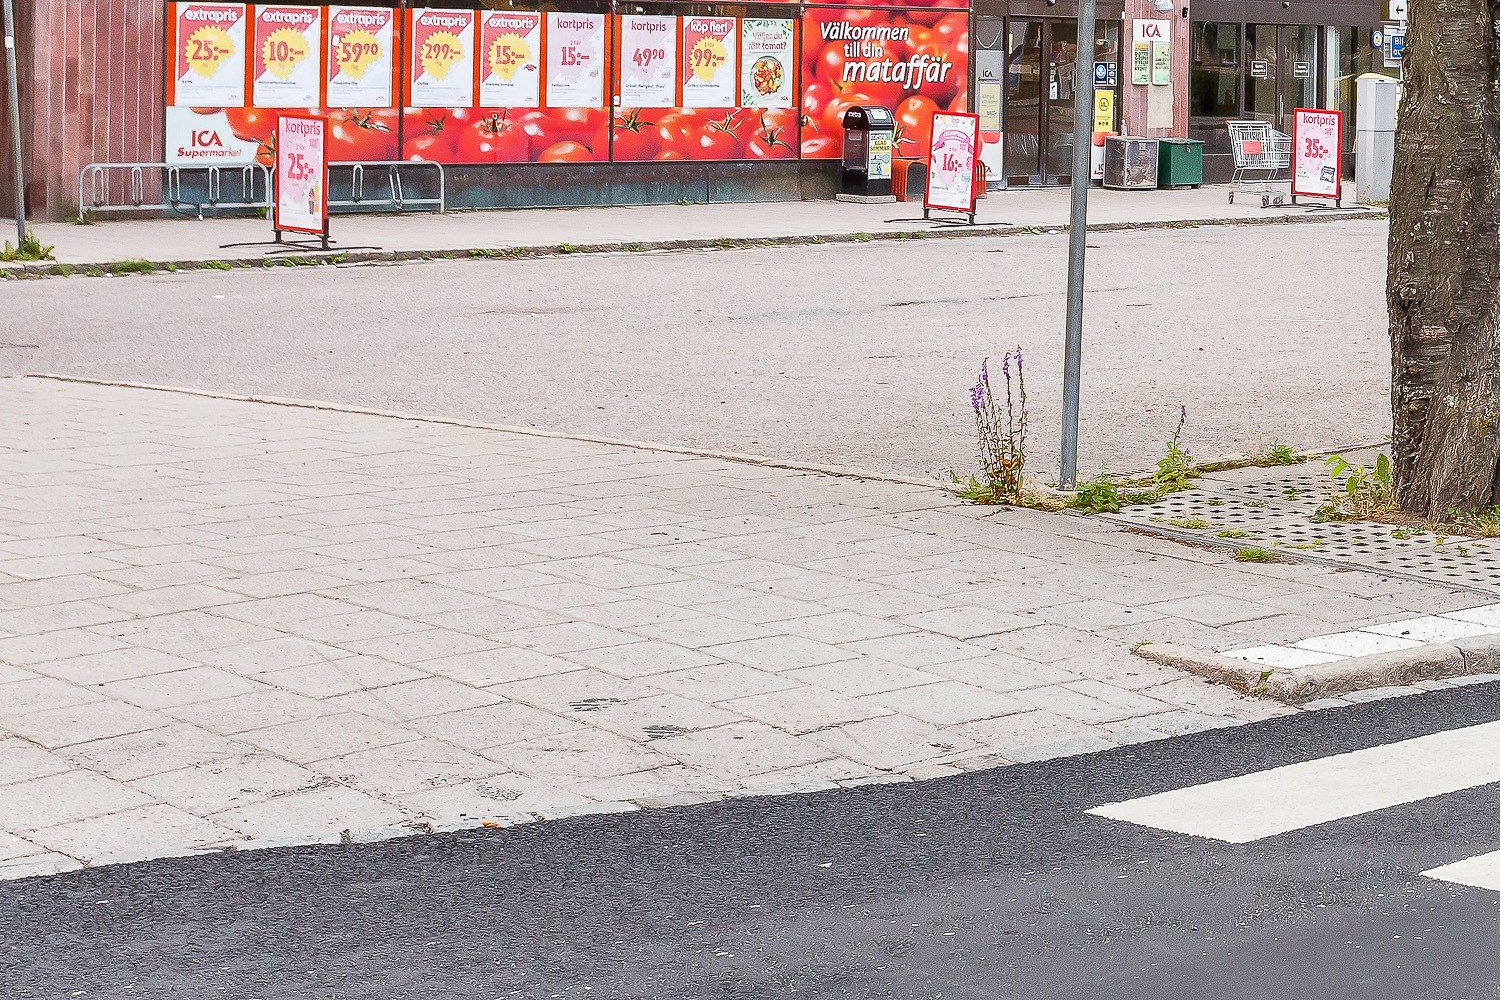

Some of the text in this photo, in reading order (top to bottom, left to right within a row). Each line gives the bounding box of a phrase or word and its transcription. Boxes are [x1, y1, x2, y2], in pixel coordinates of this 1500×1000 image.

[185, 8, 238, 24] extrapris
[262, 10, 313, 25] extrapris
[337, 13, 386, 27] extrapris
[420, 15, 467, 29] extrapris
[489, 17, 533, 30] extrapris
[557, 18, 594, 31] kortpris
[631, 21, 666, 33] kortpris
[691, 21, 708, 34] köp
[820, 21, 909, 40] Välkommen
[1142, 23, 1161, 38] ICA
[192, 40, 229, 60] 25:-
[269, 41, 304, 61] 10:-
[425, 43, 461, 59] 299:-
[761, 42, 787, 50] tomat?
[844, 41, 883, 58] till din
[496, 46, 524, 64] 15:-
[561, 47, 589, 66] 15:-
[694, 49, 724, 67] 99:-
[843, 54, 952, 89] mataffär
[982, 70, 993, 78] ICA
[285, 118, 321, 137] kortpris
[1303, 113, 1335, 127] kortpris
[192, 130, 223, 147] ICA
[177, 147, 241, 159] Supermarket
[1304, 138, 1328, 159] 35:-
[287, 152, 314, 180] 25:-
[942, 153, 962, 172] 16:-
